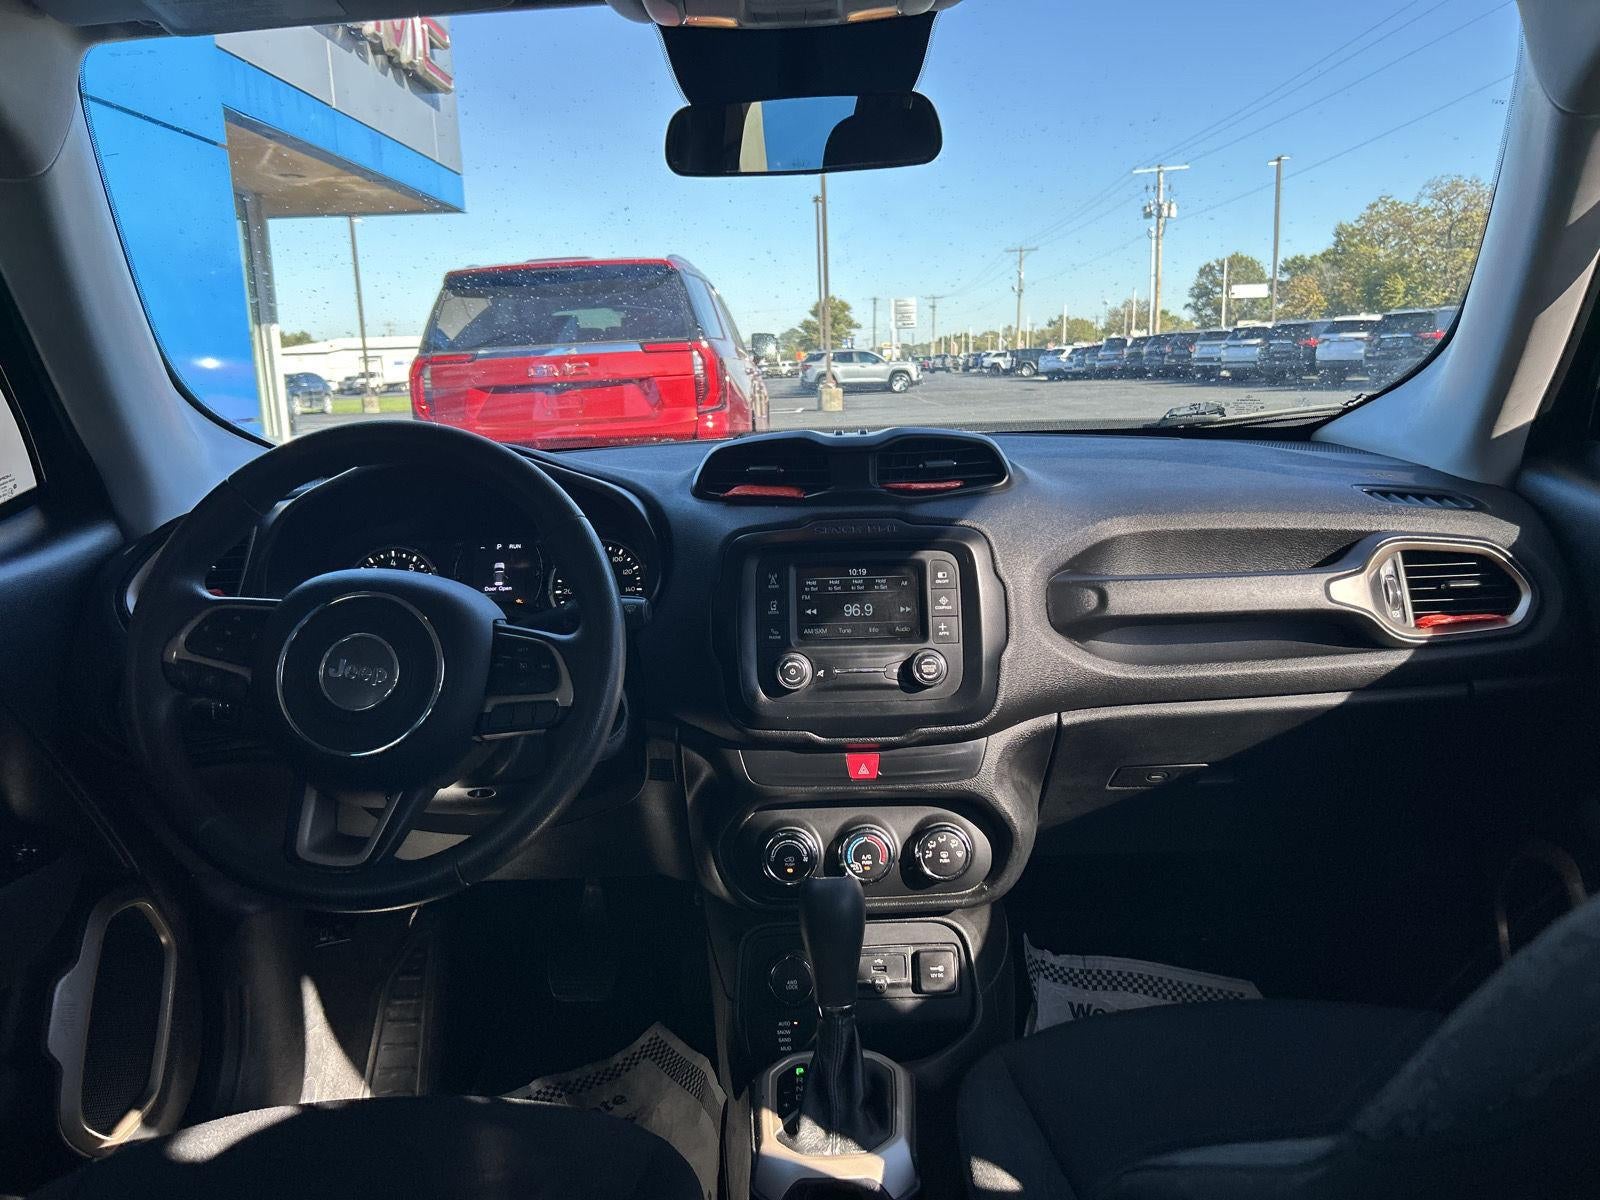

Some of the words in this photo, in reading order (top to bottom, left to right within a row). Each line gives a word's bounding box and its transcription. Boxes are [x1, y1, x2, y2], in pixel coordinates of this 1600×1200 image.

[390, 558, 397, 567] 4
[408, 563, 416, 572] 5
[848, 568, 867, 576] 10:19
[843, 603, 873, 617] 96.9
[328, 658, 388, 686] Jeep
